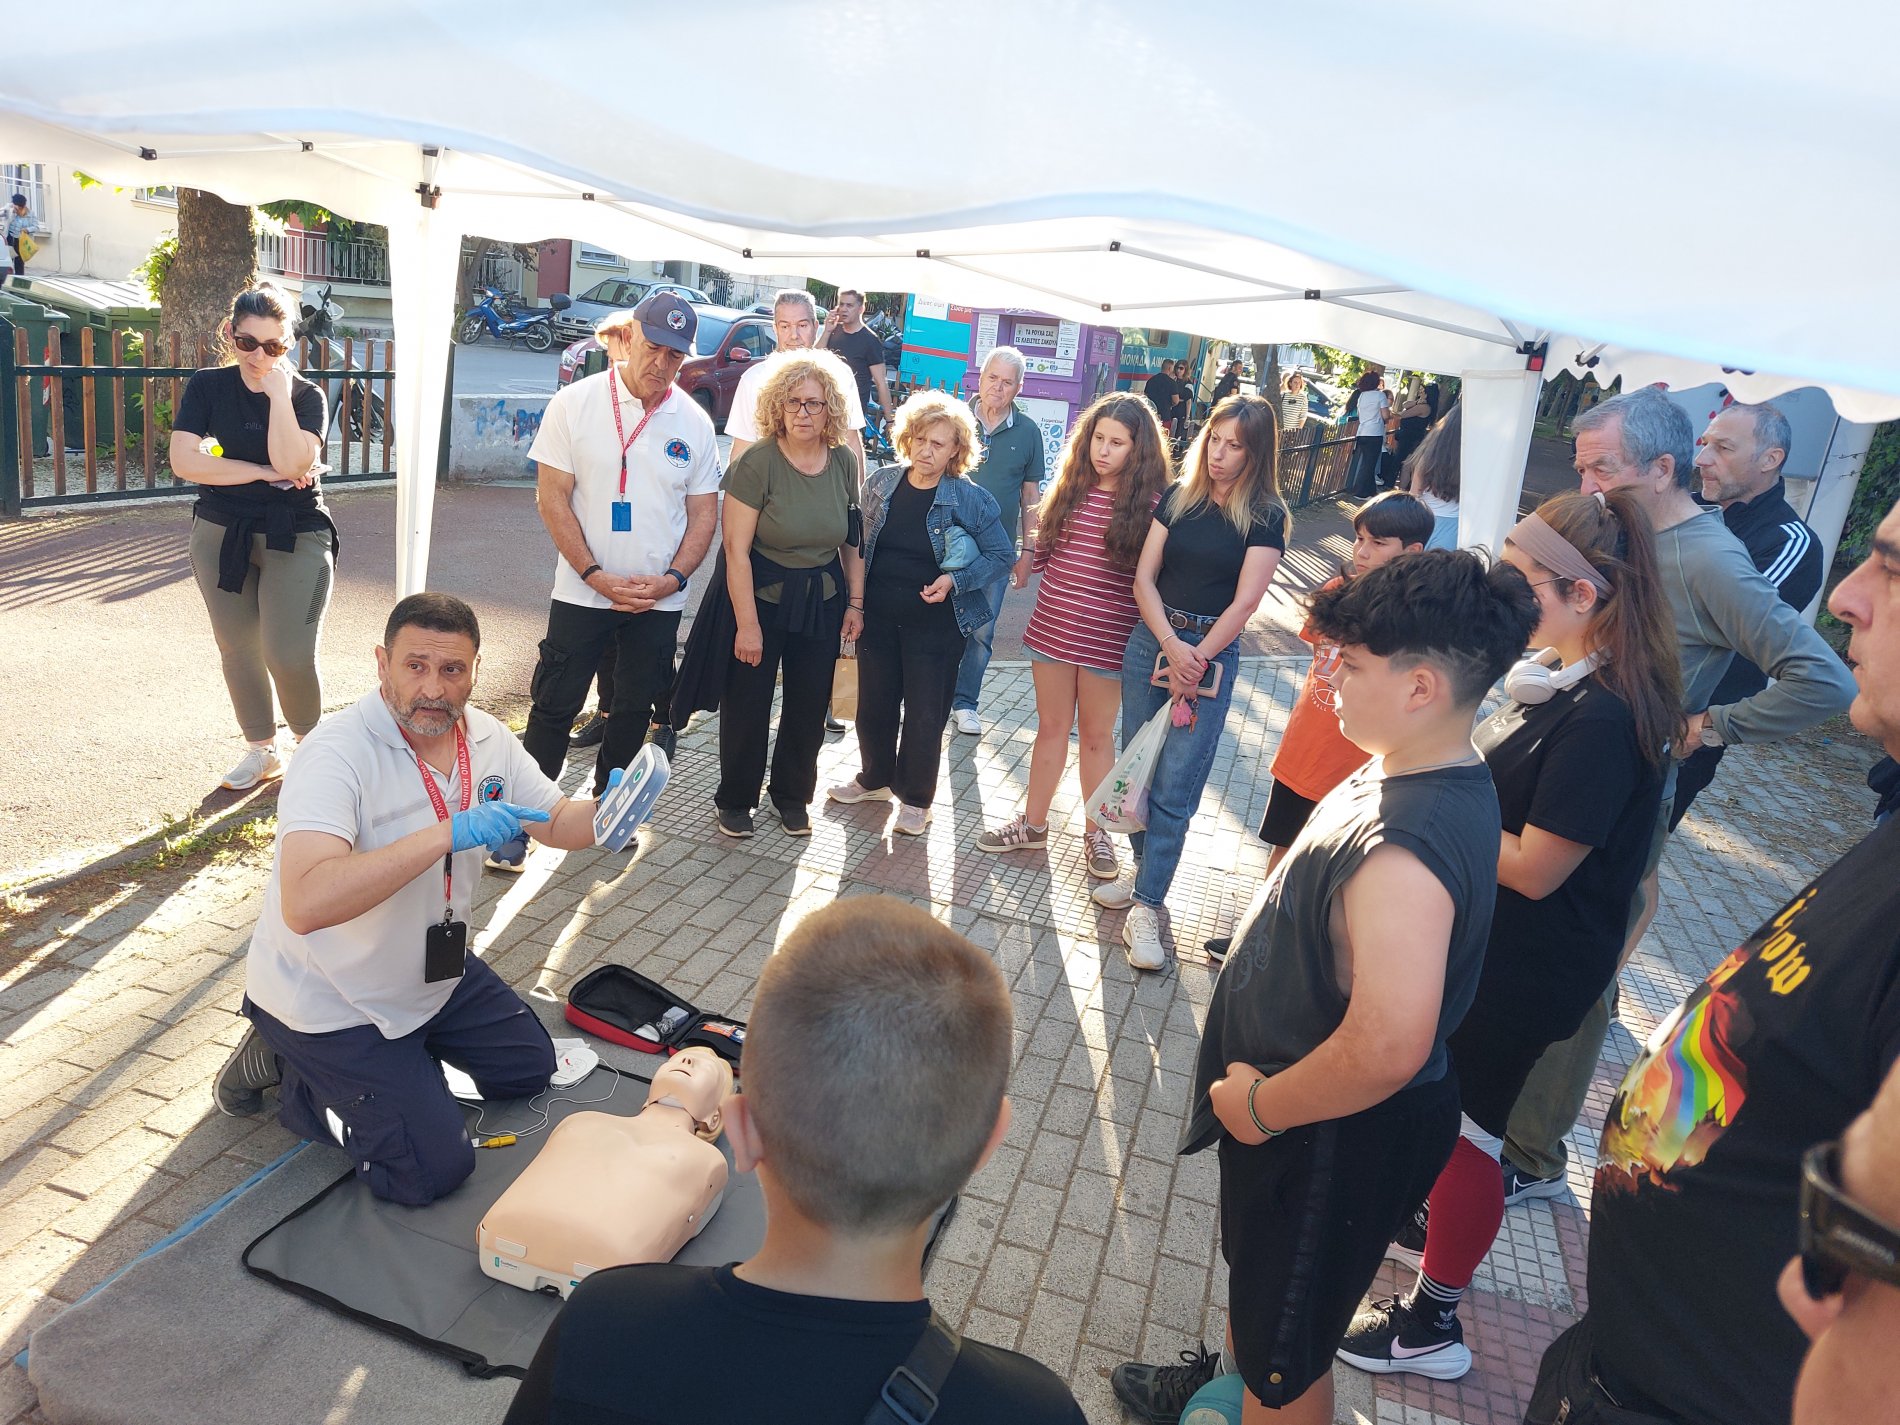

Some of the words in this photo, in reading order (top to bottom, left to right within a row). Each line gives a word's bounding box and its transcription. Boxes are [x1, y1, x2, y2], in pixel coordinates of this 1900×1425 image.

[1031, 329, 1045, 337] ΡΟΥΧΑ
[1021, 337, 1041, 345] ΚΛΕΙΣΤΕΣ
[1041, 338, 1058, 346] ΣΑΚΟΥΛ
[458, 746, 469, 774] ΟΜΑΔΑ
